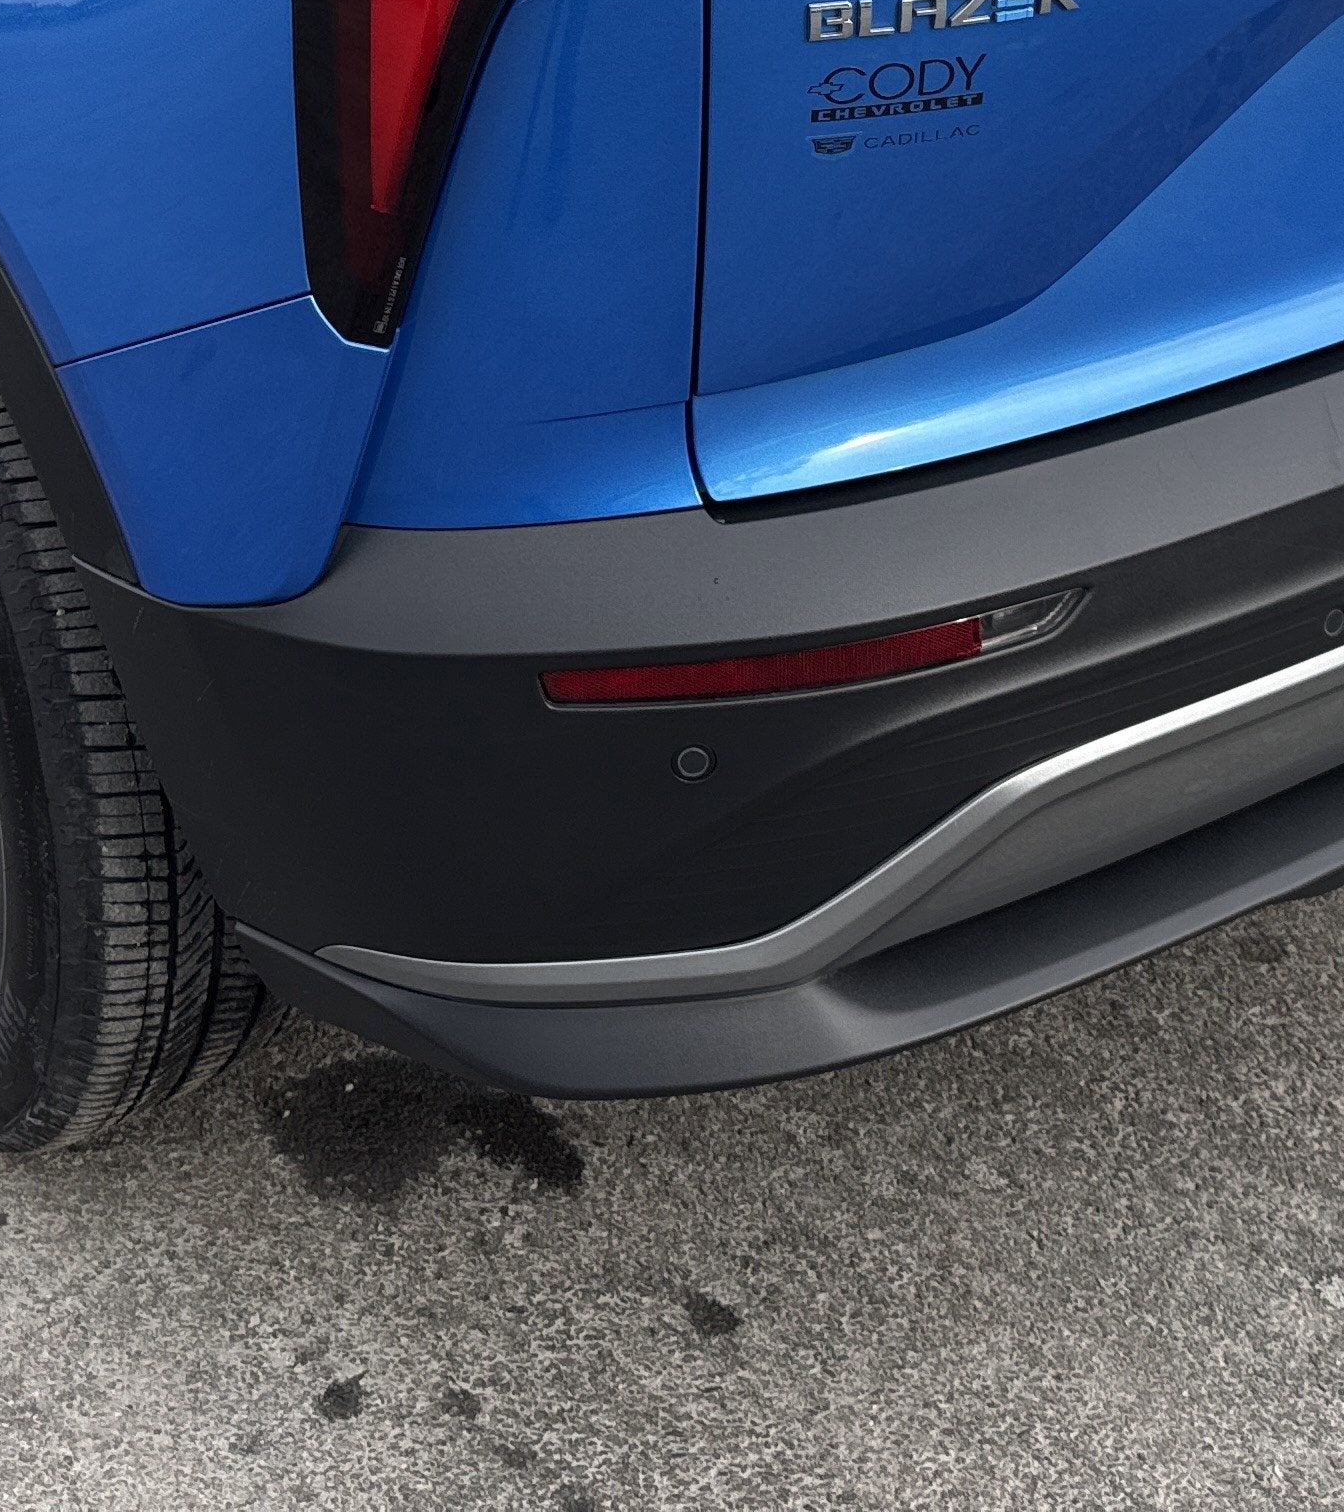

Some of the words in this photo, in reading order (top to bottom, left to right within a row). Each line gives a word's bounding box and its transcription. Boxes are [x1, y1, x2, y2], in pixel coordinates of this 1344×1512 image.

[821, 53, 988, 105] CODY
[816, 94, 980, 122] CHEVROLET
[863, 124, 981, 149] CADILLAC
